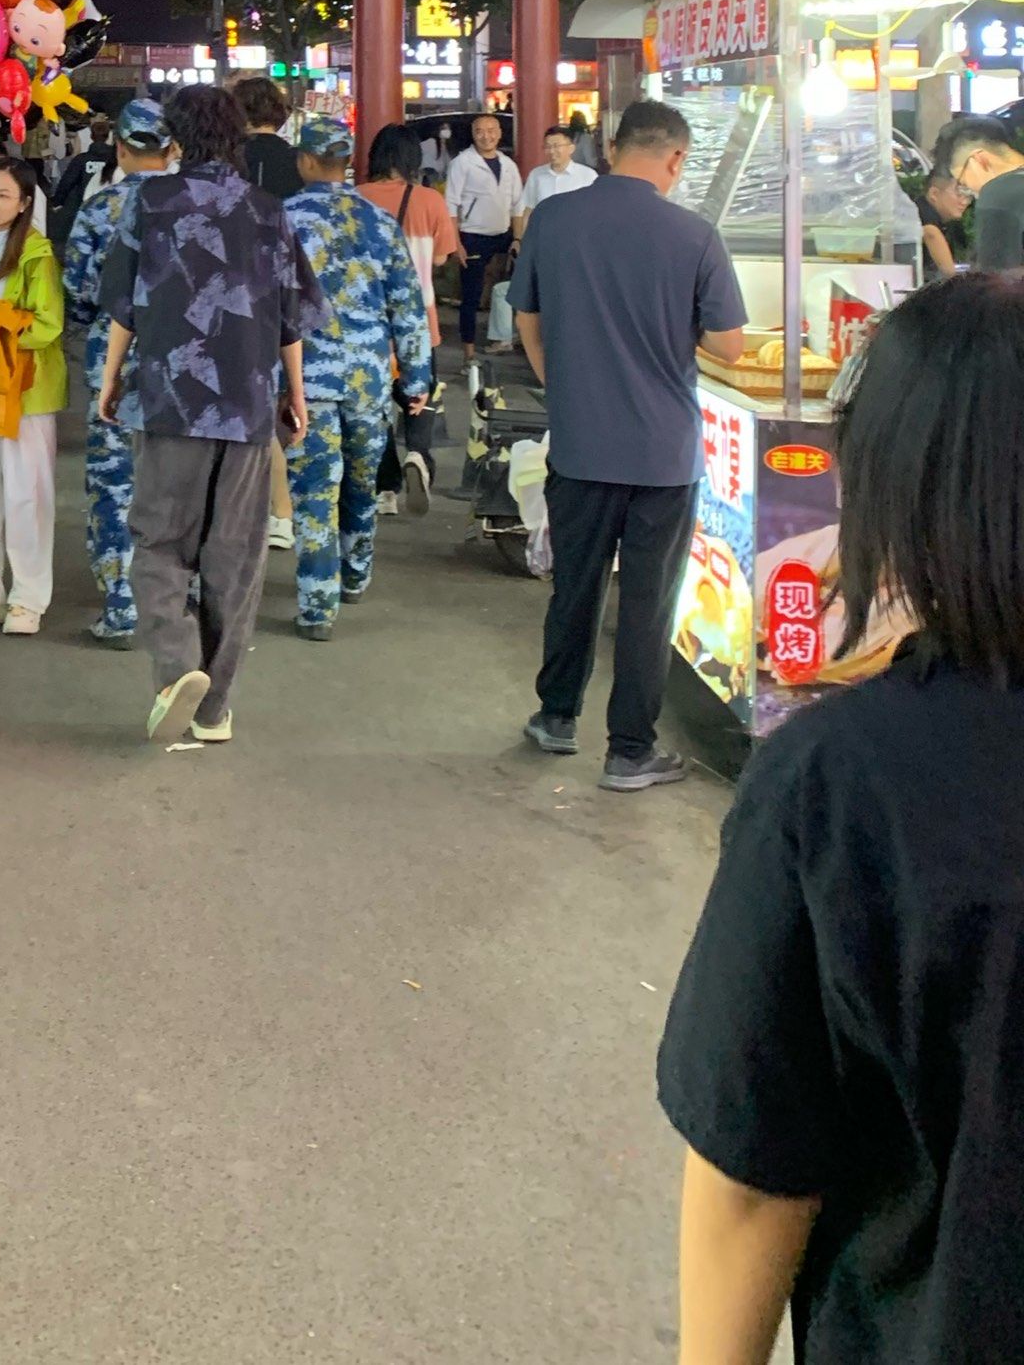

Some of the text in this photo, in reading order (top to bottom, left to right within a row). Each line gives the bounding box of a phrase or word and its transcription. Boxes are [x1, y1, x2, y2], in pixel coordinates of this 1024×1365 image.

[771, 451, 826, 471] 老潼关
[777, 583, 816, 663] 现烤
